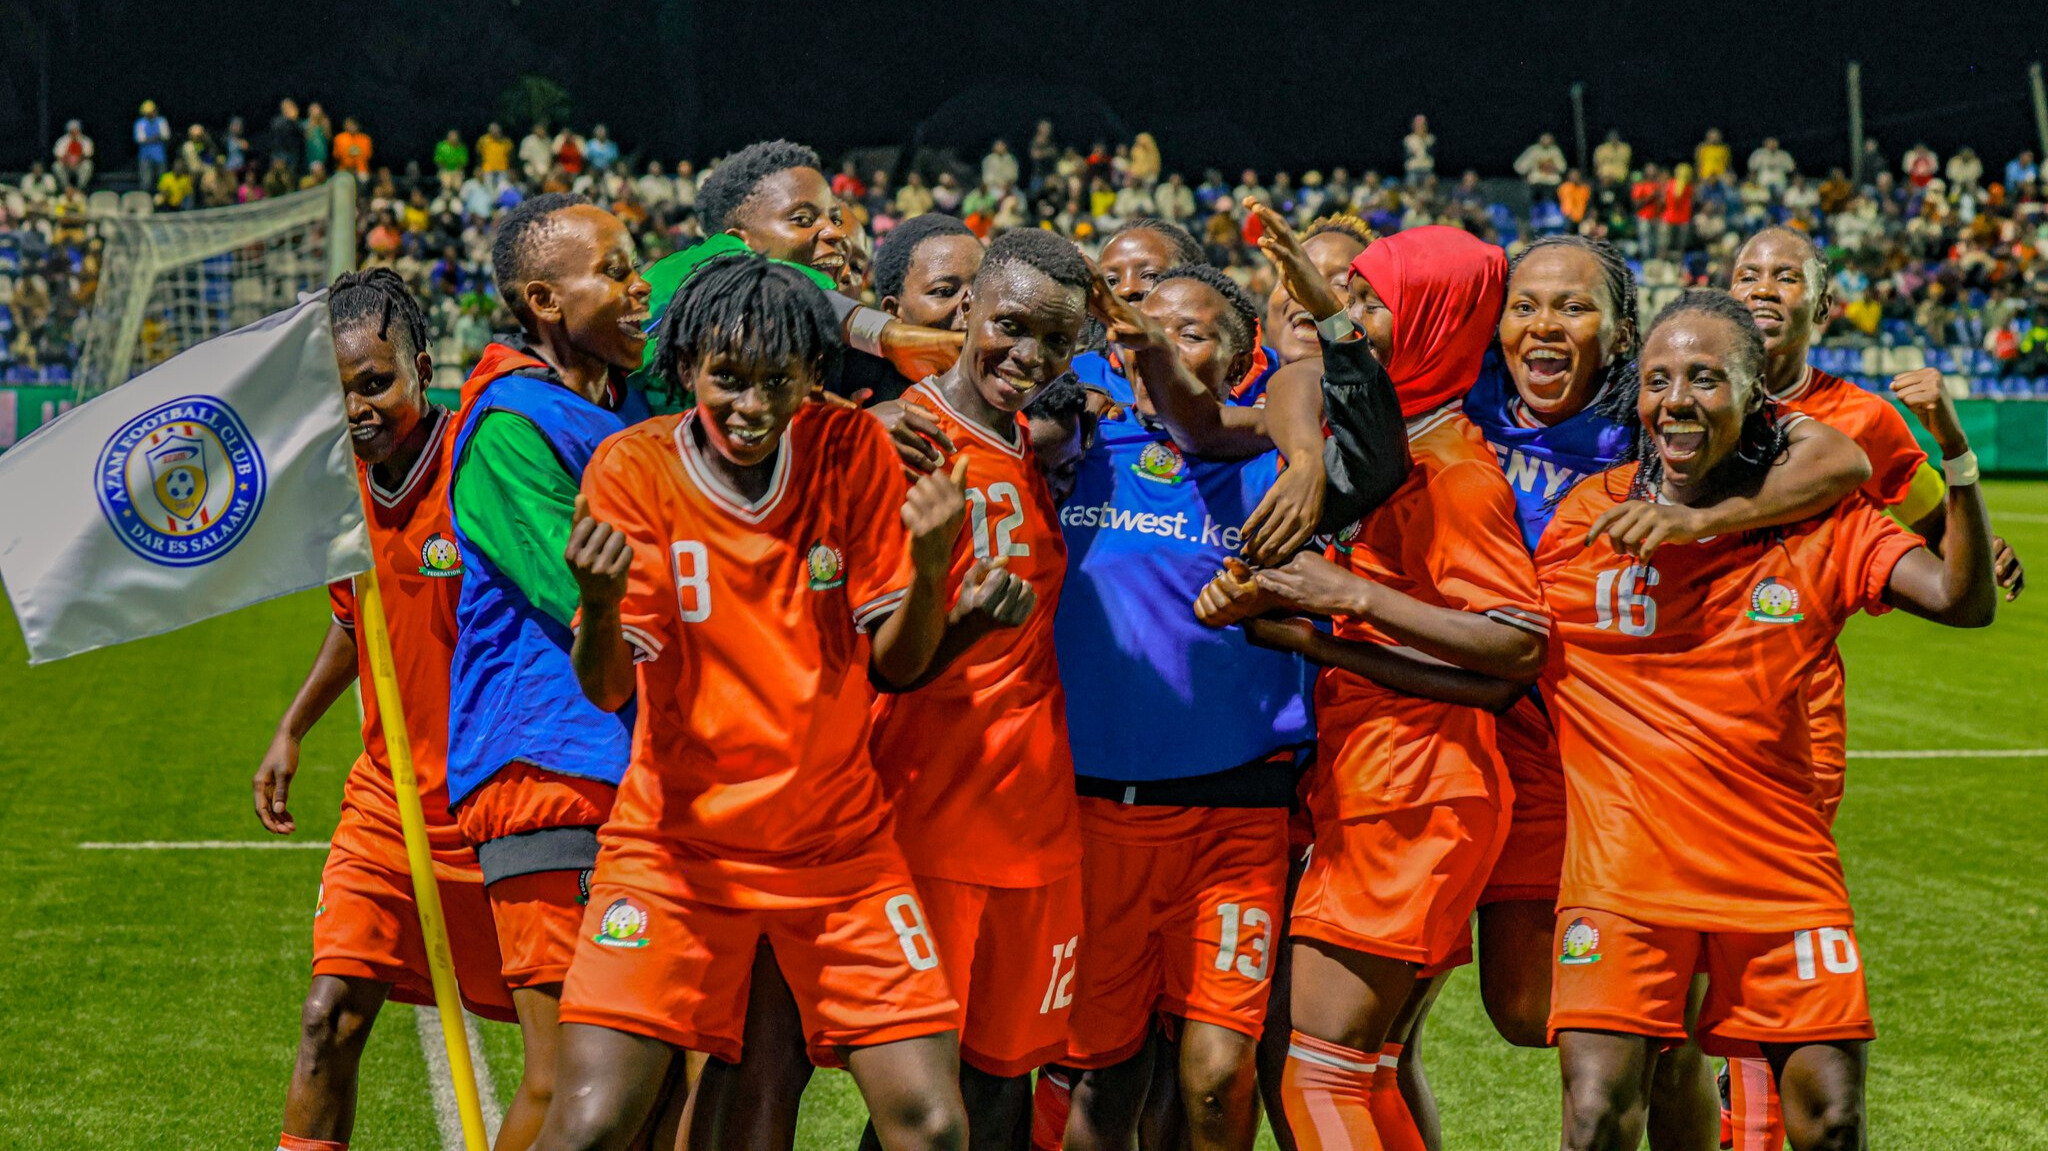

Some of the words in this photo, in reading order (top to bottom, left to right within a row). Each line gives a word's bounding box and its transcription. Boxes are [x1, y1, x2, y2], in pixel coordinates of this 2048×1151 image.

[106, 451, 128, 503] AZAM
[120, 405, 220, 449] FOOTBALL
[220, 425, 252, 475] CLUB
[130, 523, 164, 551] DAR
[168, 539, 188, 553] ES
[190, 498, 250, 552] SALAAM
[422, 538, 433, 567] FOOTBALL
[965, 481, 1030, 559] 12
[1060, 501, 1242, 550] eastwest.ke
[427, 569, 461, 577] FEDERATION
[671, 540, 711, 623] 8
[1594, 564, 1660, 637] 16
[884, 893, 939, 971] 8
[1215, 902, 1272, 982] 13
[1039, 935, 1078, 1014] 12
